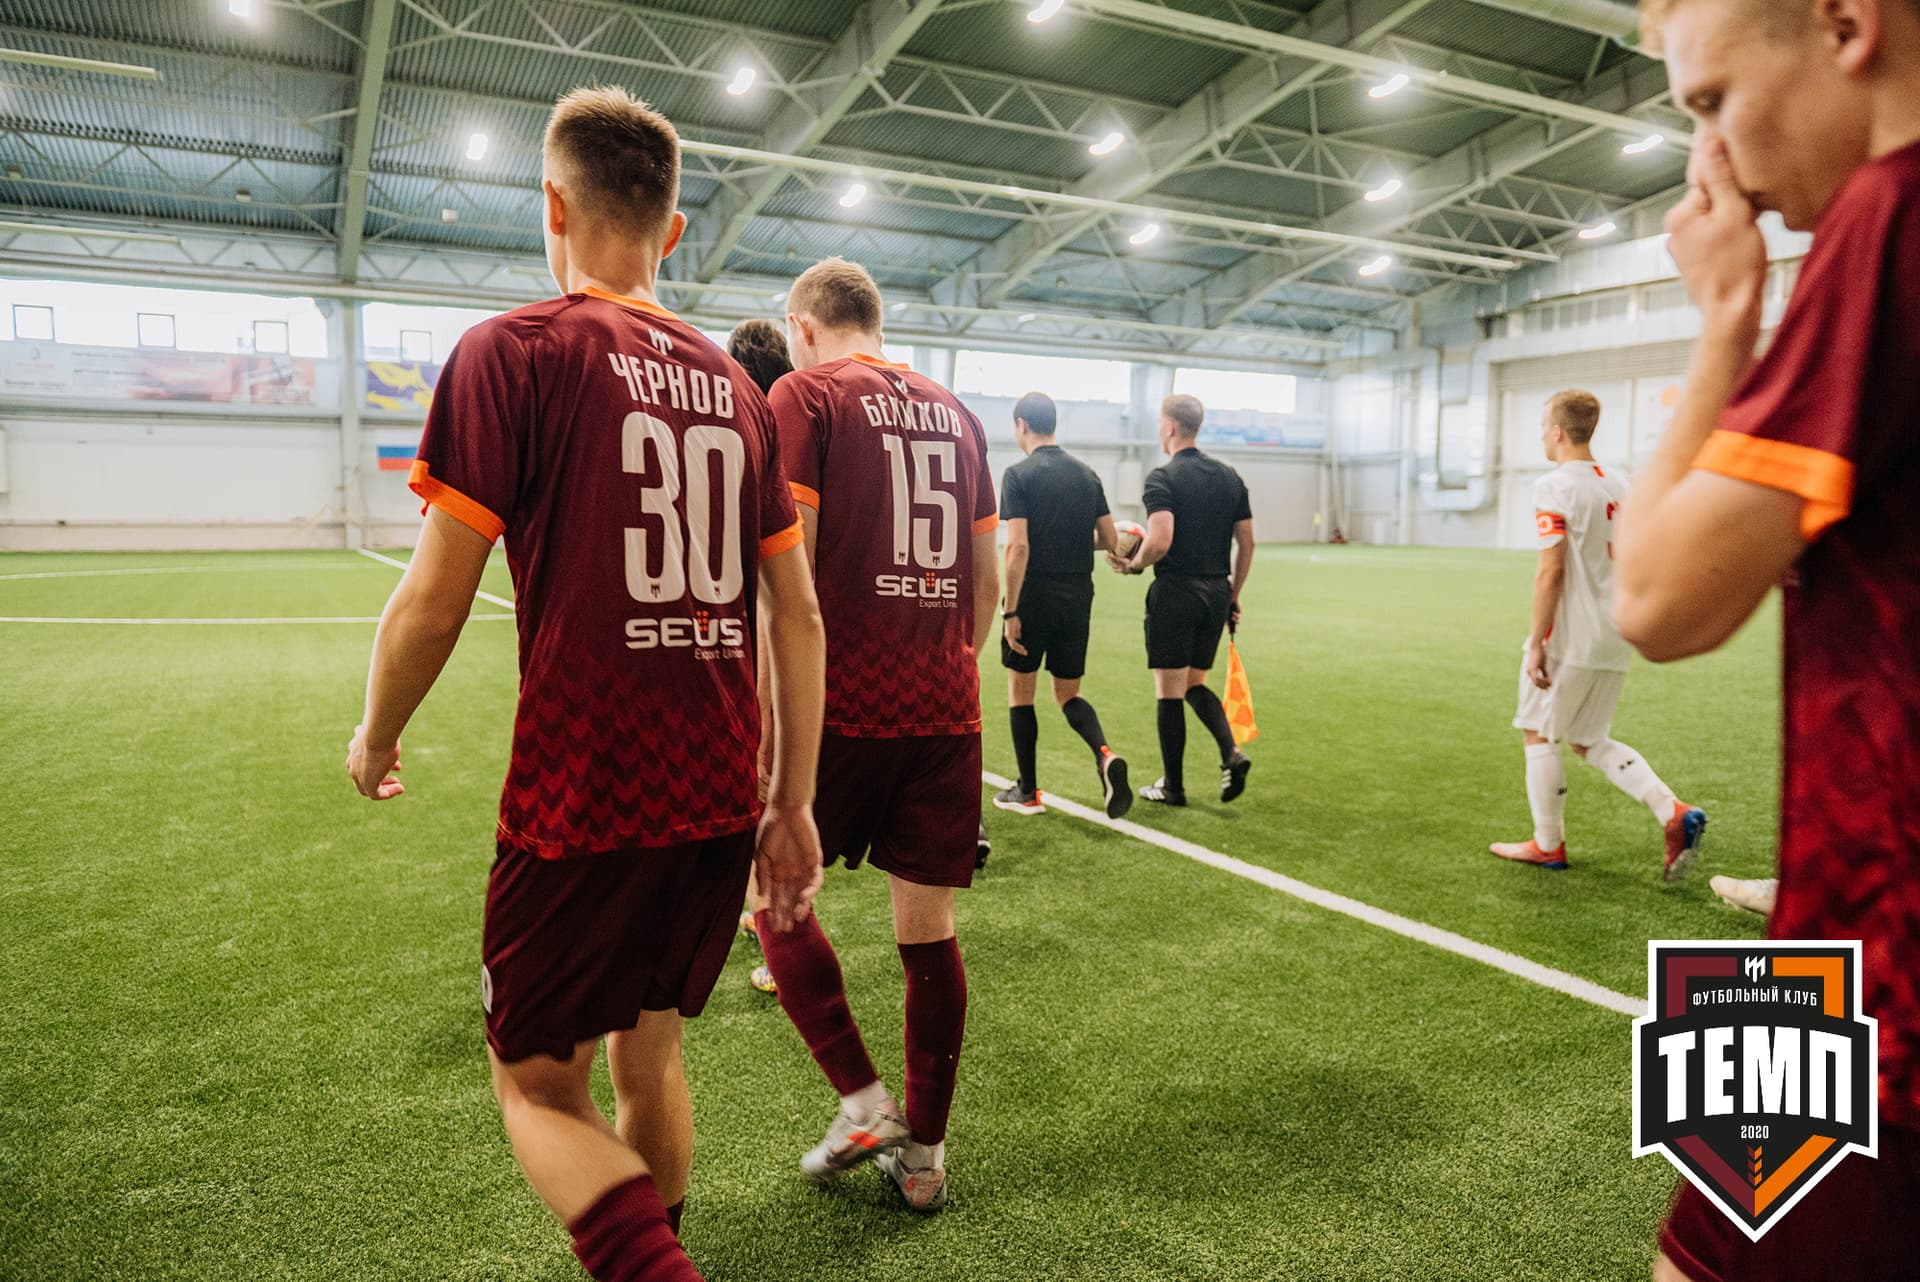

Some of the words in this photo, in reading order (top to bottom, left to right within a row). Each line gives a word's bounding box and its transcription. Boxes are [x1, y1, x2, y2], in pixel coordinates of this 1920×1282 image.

[607, 352, 734, 419] ЧЕРНОВ
[859, 393, 962, 438] БЕЛИКОВ
[621, 411, 745, 604] 30
[882, 433, 958, 570] 15
[875, 574, 958, 599] SEUS
[625, 617, 744, 649] SEUS
